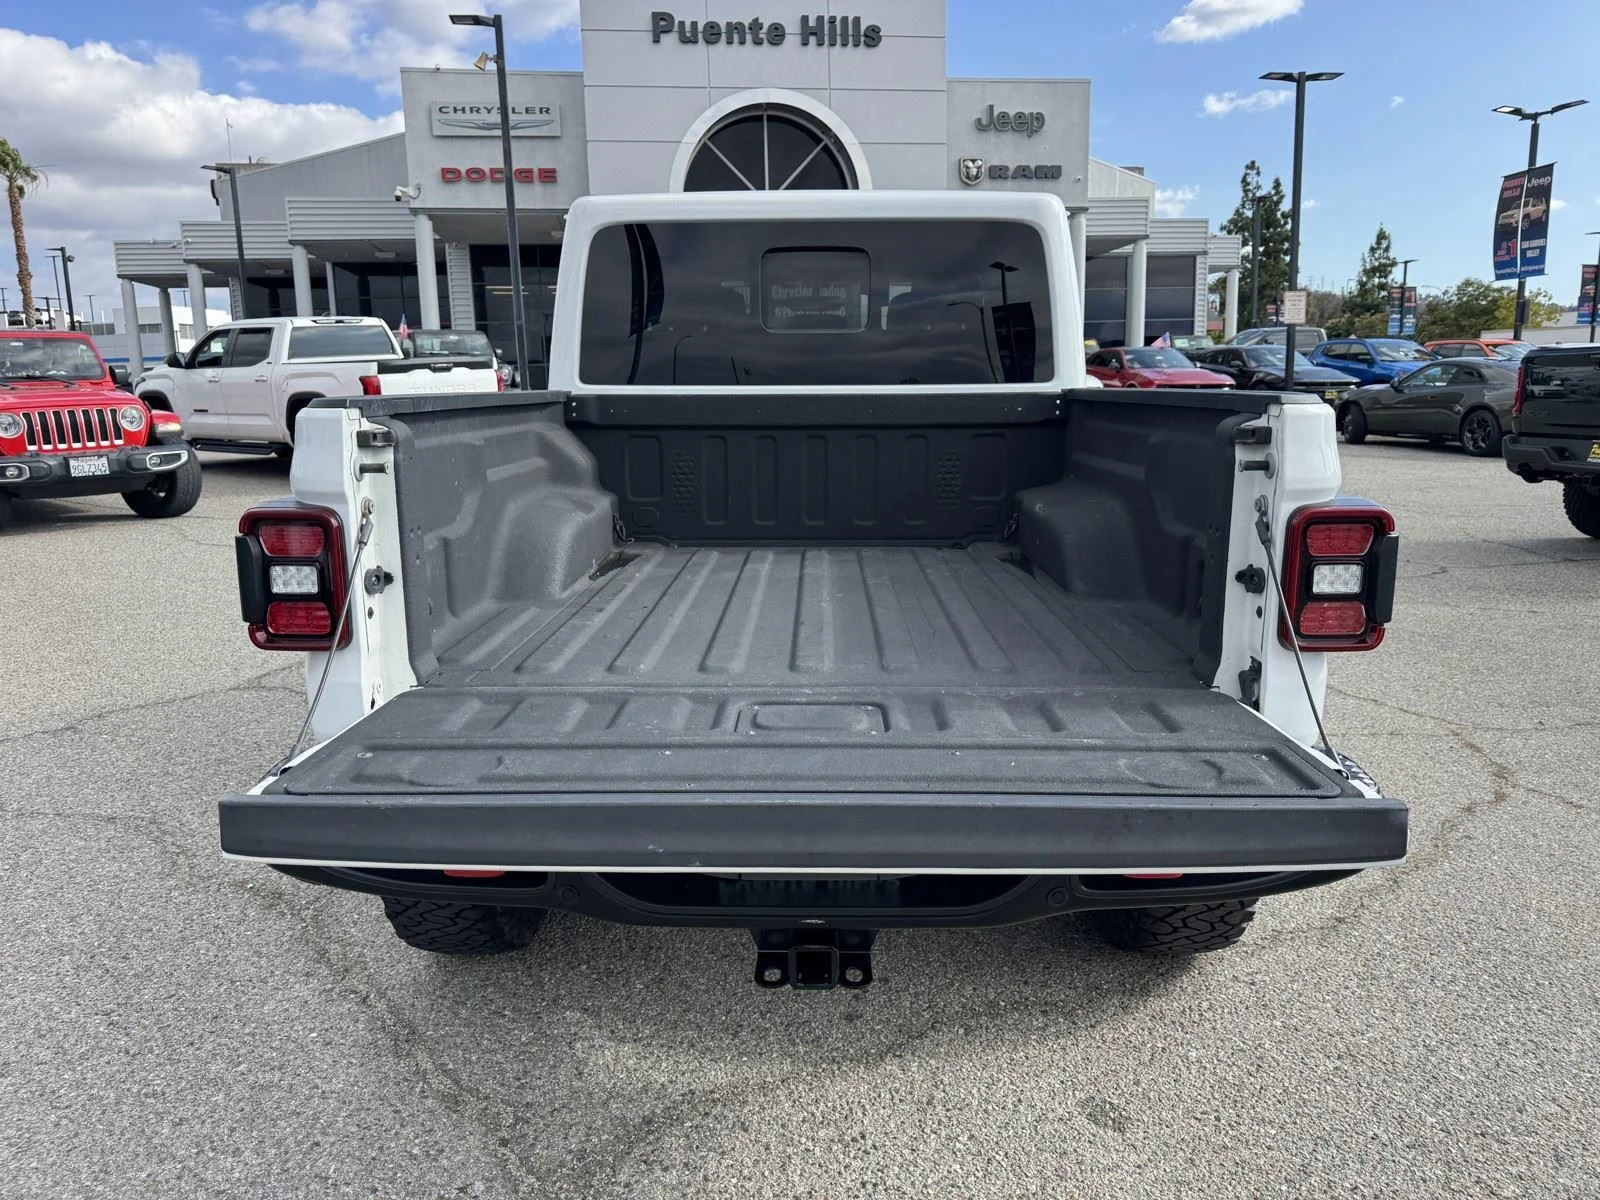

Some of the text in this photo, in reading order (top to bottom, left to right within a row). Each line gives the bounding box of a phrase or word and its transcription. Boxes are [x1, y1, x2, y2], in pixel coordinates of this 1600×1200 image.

[651, 11, 882, 48] Puente Hills
[975, 104, 1045, 137] Jeep
[440, 167, 558, 183] DODGE
[988, 165, 1062, 180] RAM
[1528, 176, 1551, 187] Jeep
